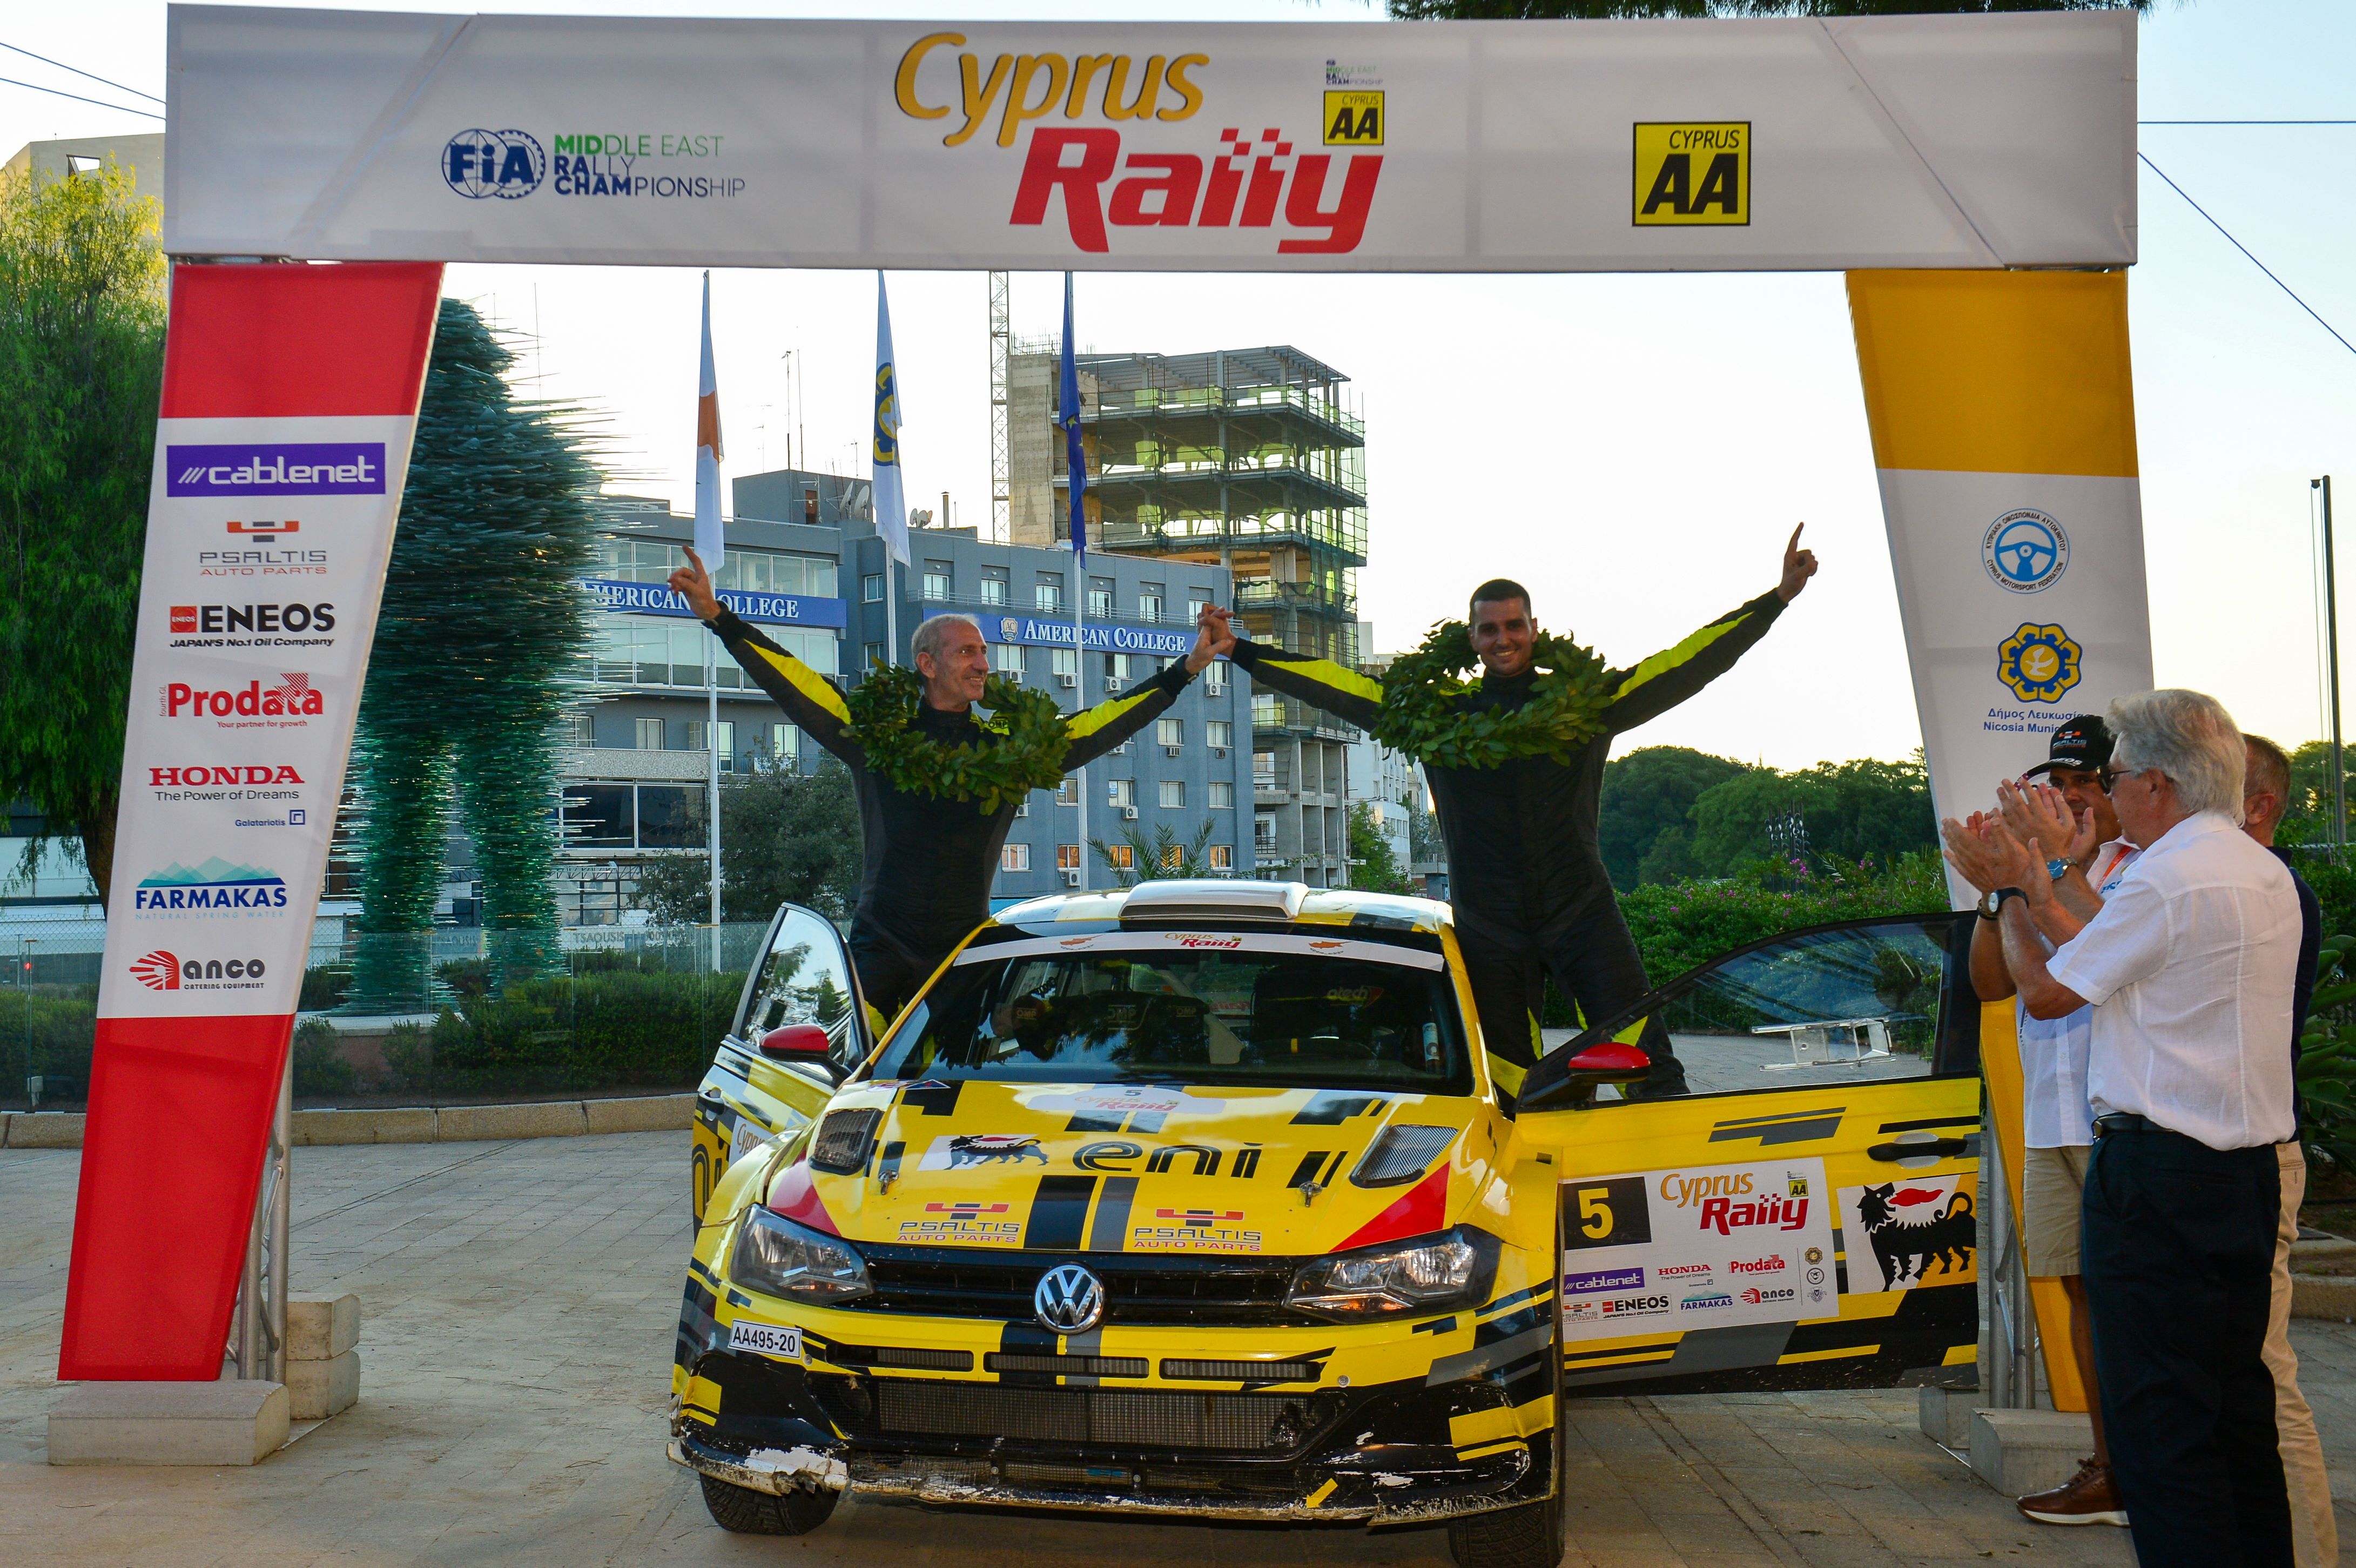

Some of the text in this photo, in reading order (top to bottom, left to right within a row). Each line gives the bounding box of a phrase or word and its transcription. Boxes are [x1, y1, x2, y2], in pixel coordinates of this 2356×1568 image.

[895, 31, 1210, 147] Cyprus
[1342, 94, 1379, 105] CYPRUS
[1328, 107, 1378, 139] AA
[554, 134, 724, 157] MIDDLE EAST
[1669, 130, 1740, 149] CYPRUS
[554, 156, 636, 176] RALLY
[554, 176, 746, 198] CHAMPIONSHIP
[1640, 152, 1739, 214] AA
[208, 455, 376, 484] cablenet
[200, 550, 327, 563] PSALTIS
[200, 566, 327, 576] AUTO PARTS
[1987, 559, 2064, 590] CYPRUS MOTORSPORT FEDERATION
[717, 594, 799, 618] OLLEGE
[201, 603, 335, 632] ENEOS
[170, 637, 334, 648] JAPAN'S No.1 Oil Company
[1025, 620, 1186, 652] AMERICAN COLLEGE
[168, 680, 324, 717] Prodata
[1988, 708, 2025, 720] Δήμος
[217, 721, 234, 729] Your
[236, 719, 265, 729] partner
[280, 719, 307, 729] growth
[1983, 721, 2024, 732] Nicosia
[149, 765, 305, 786] HONDA
[155, 790, 299, 801] The Power of Dreams
[235, 819, 286, 827] Galatariotis
[136, 887, 287, 910] FARMAKAS
[573, 931, 625, 944] TSAOUSIS
[183, 959, 265, 979] anco
[1017, 1008, 1037, 1018] OMP
[1072, 1141, 1263, 1179] eni
[1661, 1173, 1753, 1209] Cyprus
[1791, 1185, 1807, 1195] AA
[1578, 1188, 1613, 1239] 5
[899, 1221, 1021, 1233] PSALTIS
[1134, 1228, 1262, 1241] PSALTIS
[897, 1234, 1018, 1243] AUTO PARTS
[1133, 1240, 1262, 1251] AUTO PARTS
[1658, 1264, 1712, 1275] HONDA
[1730, 1258, 1785, 1274] Prodata
[1576, 1273, 1641, 1289] cablenet
[1761, 1288, 1794, 1299] anco
[1614, 1296, 1670, 1312] ENEOS
[1681, 1299, 1733, 1310] FARMAKAS
[732, 1329, 796, 1353] AA495-20
